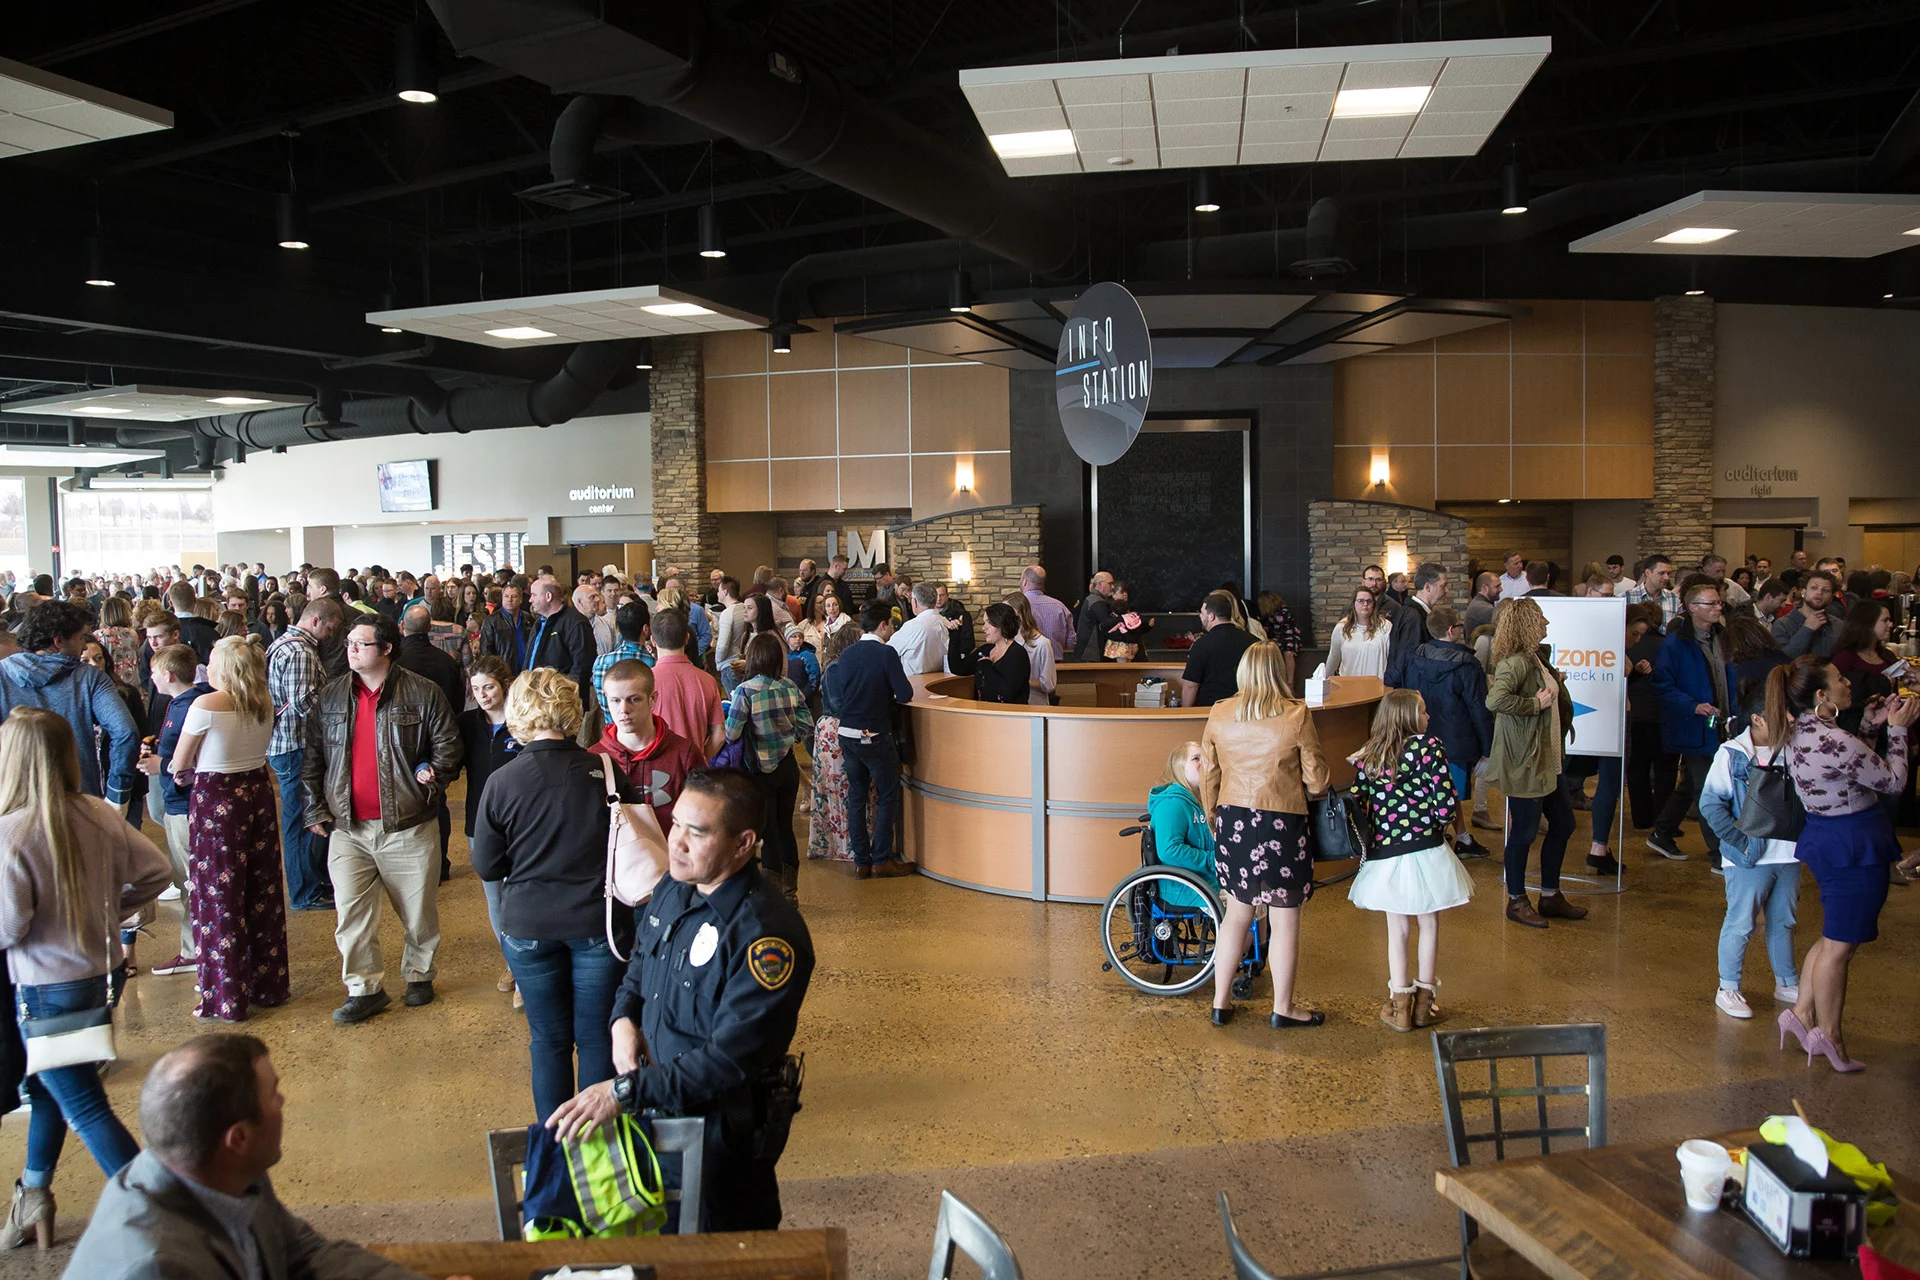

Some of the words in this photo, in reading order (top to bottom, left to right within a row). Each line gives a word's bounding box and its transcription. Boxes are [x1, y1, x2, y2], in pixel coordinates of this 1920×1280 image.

[1068, 316, 1113, 363] INFO
[1083, 359, 1148, 409] STATION
[1725, 464, 1799, 481] auditorium
[569, 484, 635, 501] auditorium
[588, 504, 615, 513] center
[1552, 643, 1616, 668] zone
[1565, 669, 1597, 681] heck
[1602, 669, 1614, 681] in
